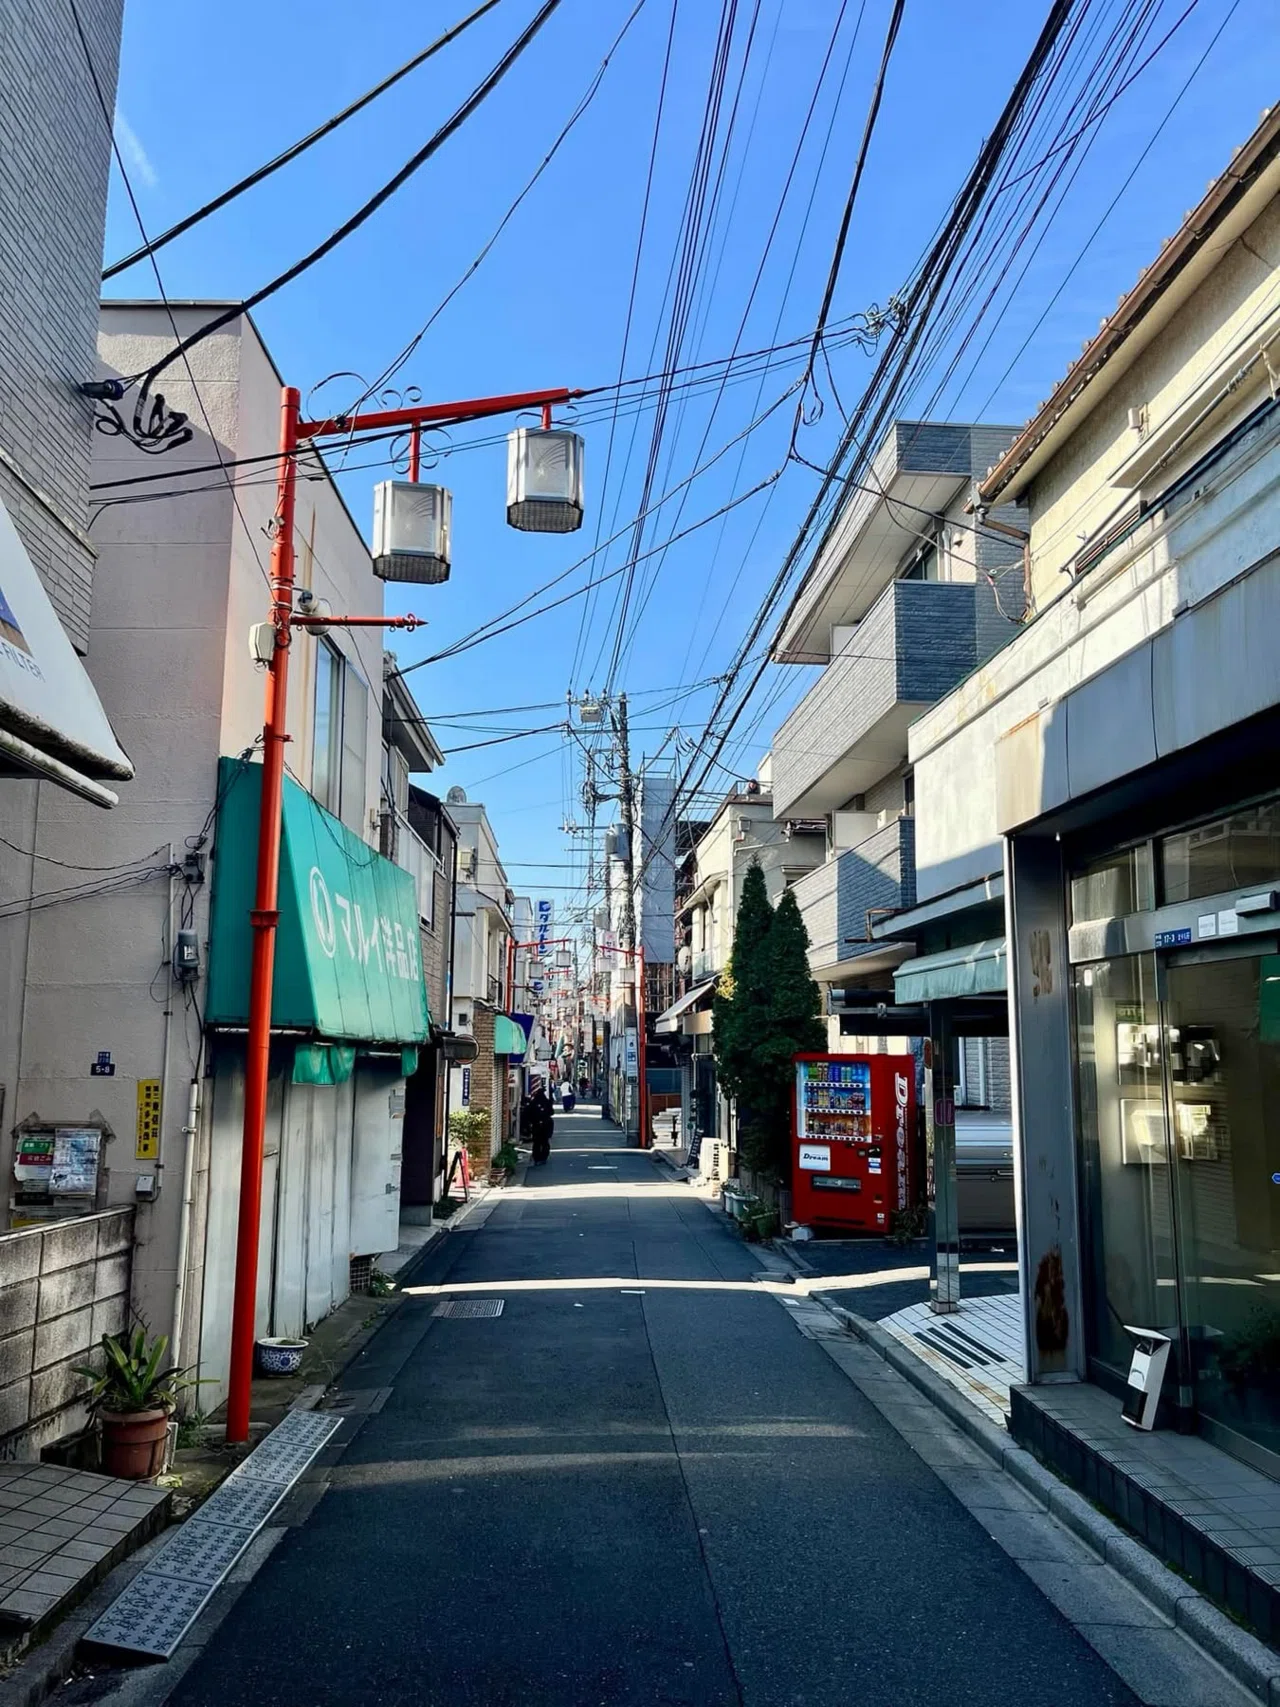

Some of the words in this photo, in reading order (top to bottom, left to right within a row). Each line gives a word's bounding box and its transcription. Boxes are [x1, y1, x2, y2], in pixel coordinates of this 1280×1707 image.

[1, 642, 46, 683] FILTER
[335, 893, 419, 981] マルイ洋品店
[803, 1153, 829, 1162] Dream
